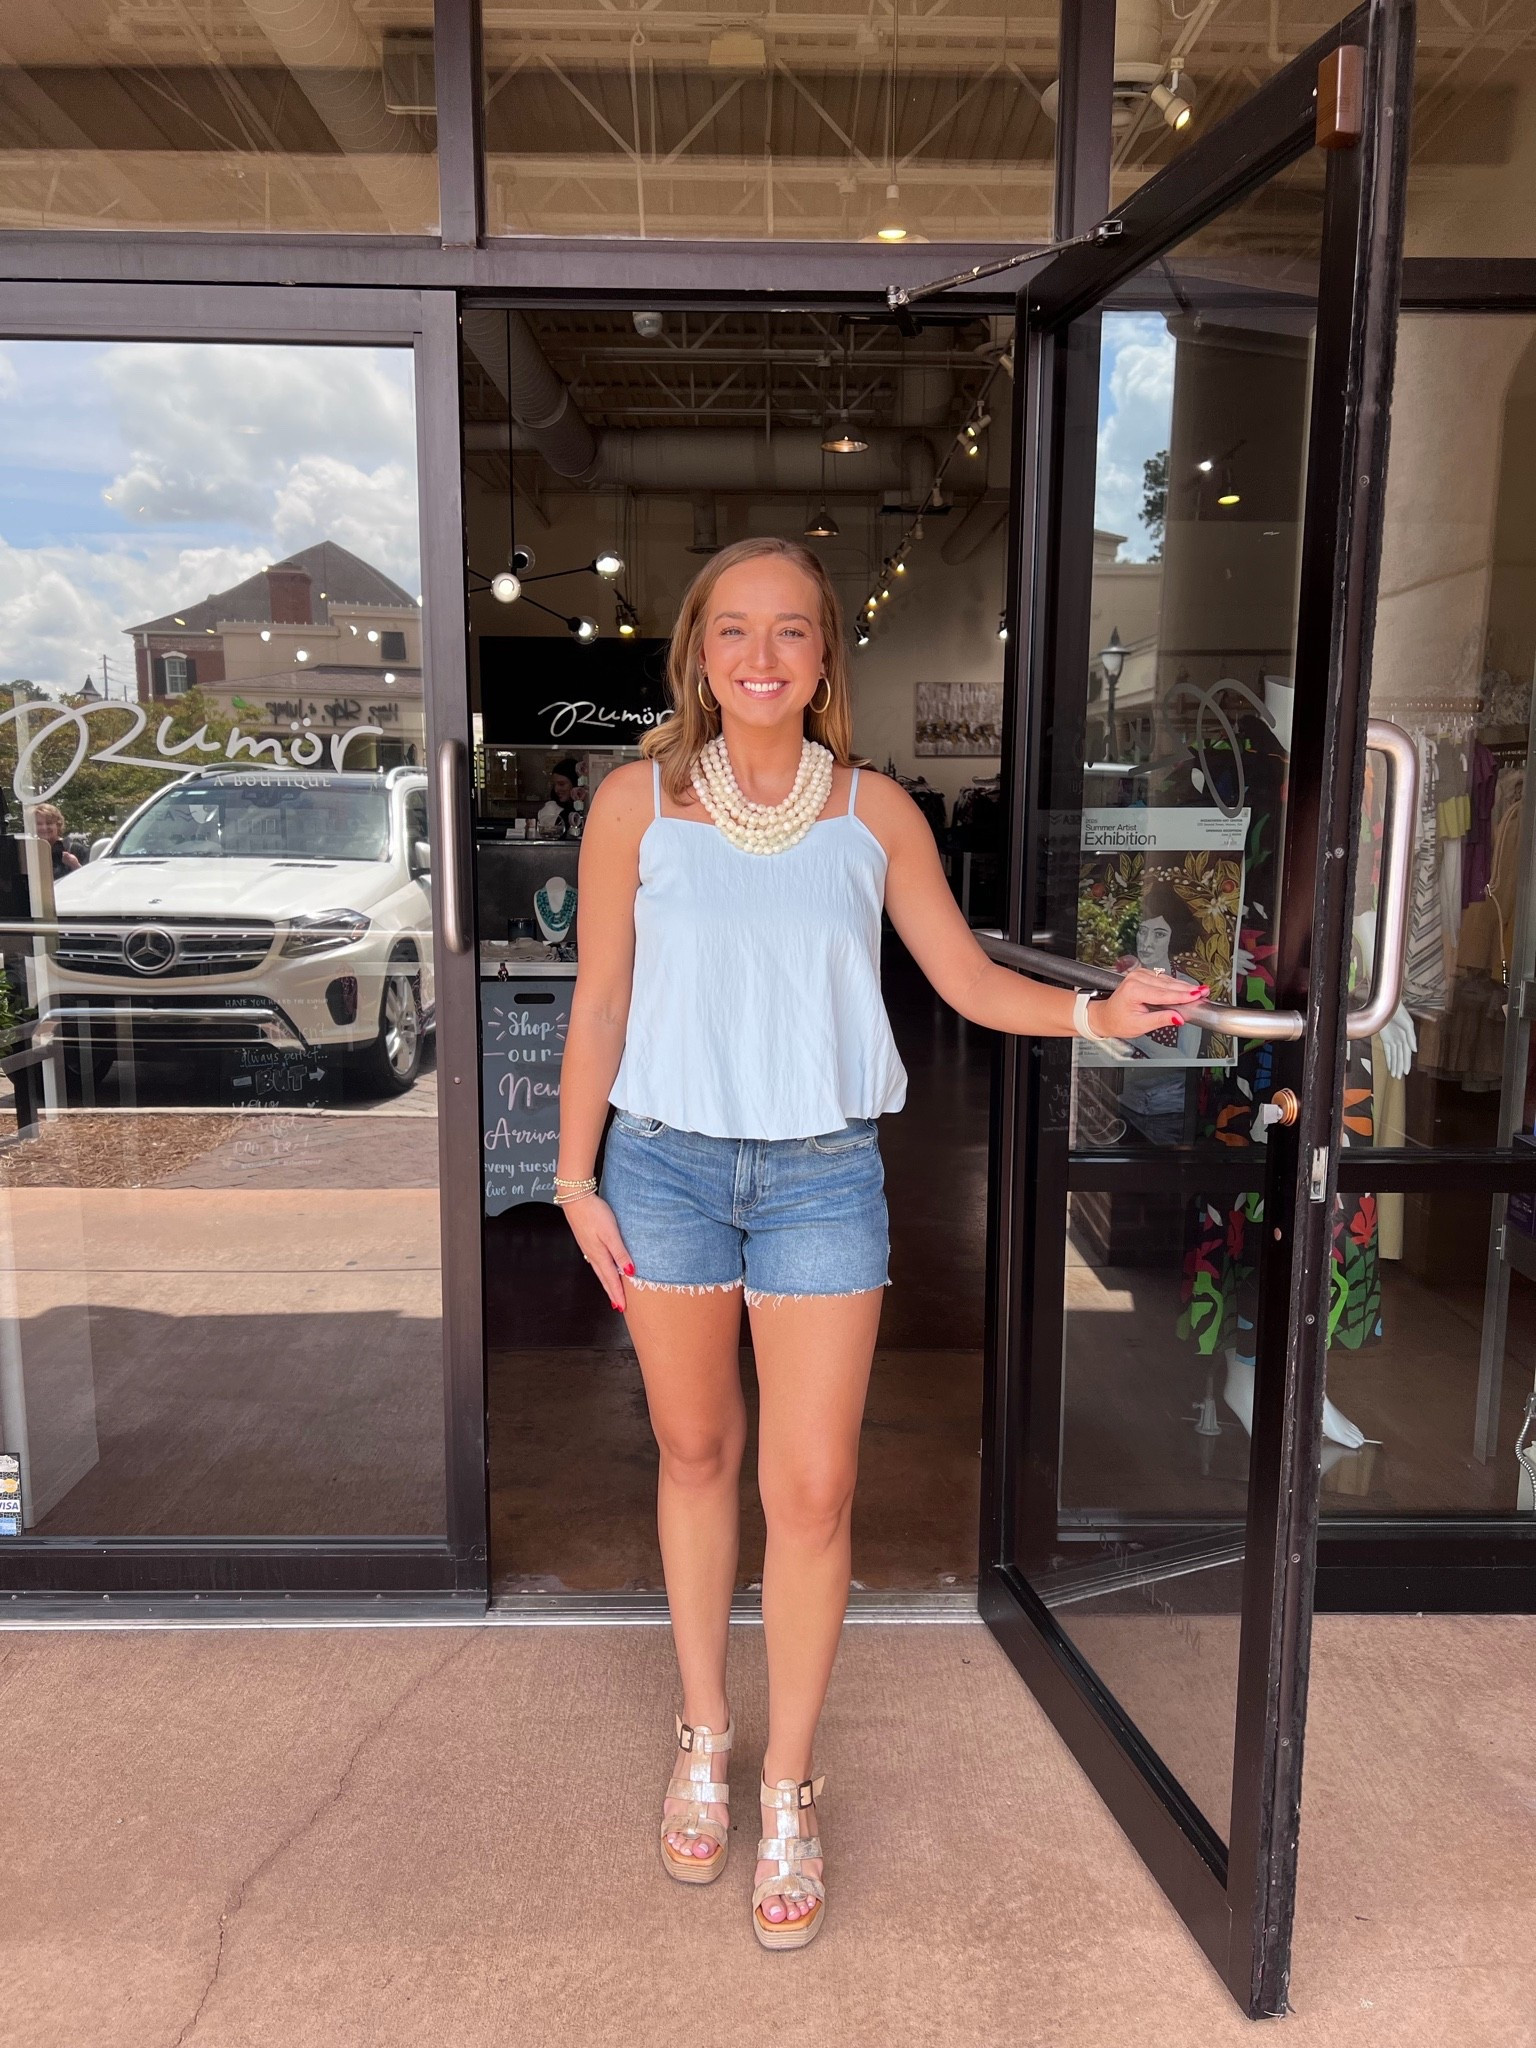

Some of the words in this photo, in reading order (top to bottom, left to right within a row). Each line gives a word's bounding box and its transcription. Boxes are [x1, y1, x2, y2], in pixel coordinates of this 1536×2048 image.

[0, 701, 384, 803] Rumör
[213, 775, 225, 787] A
[233, 774, 332, 789] BOUTIQUE
[1085, 823, 1115, 832] Summer
[1117, 823, 1137, 831] Artist
[1084, 831, 1157, 846] Exhibition
[224, 998, 248, 1008] HAVE
[250, 998, 266, 1007] YOU
[507, 1011, 555, 1041] Shop
[240, 1048, 280, 1068] always
[507, 1047, 552, 1063] our
[255, 1064, 308, 1095] BUT
[498, 1071, 560, 1112] New
[484, 1117, 560, 1151] Arriva
[517, 1158, 557, 1174] tuesd
[485, 1179, 508, 1198] live
[511, 1184, 525, 1195] on
[530, 1176, 557, 1198] face
